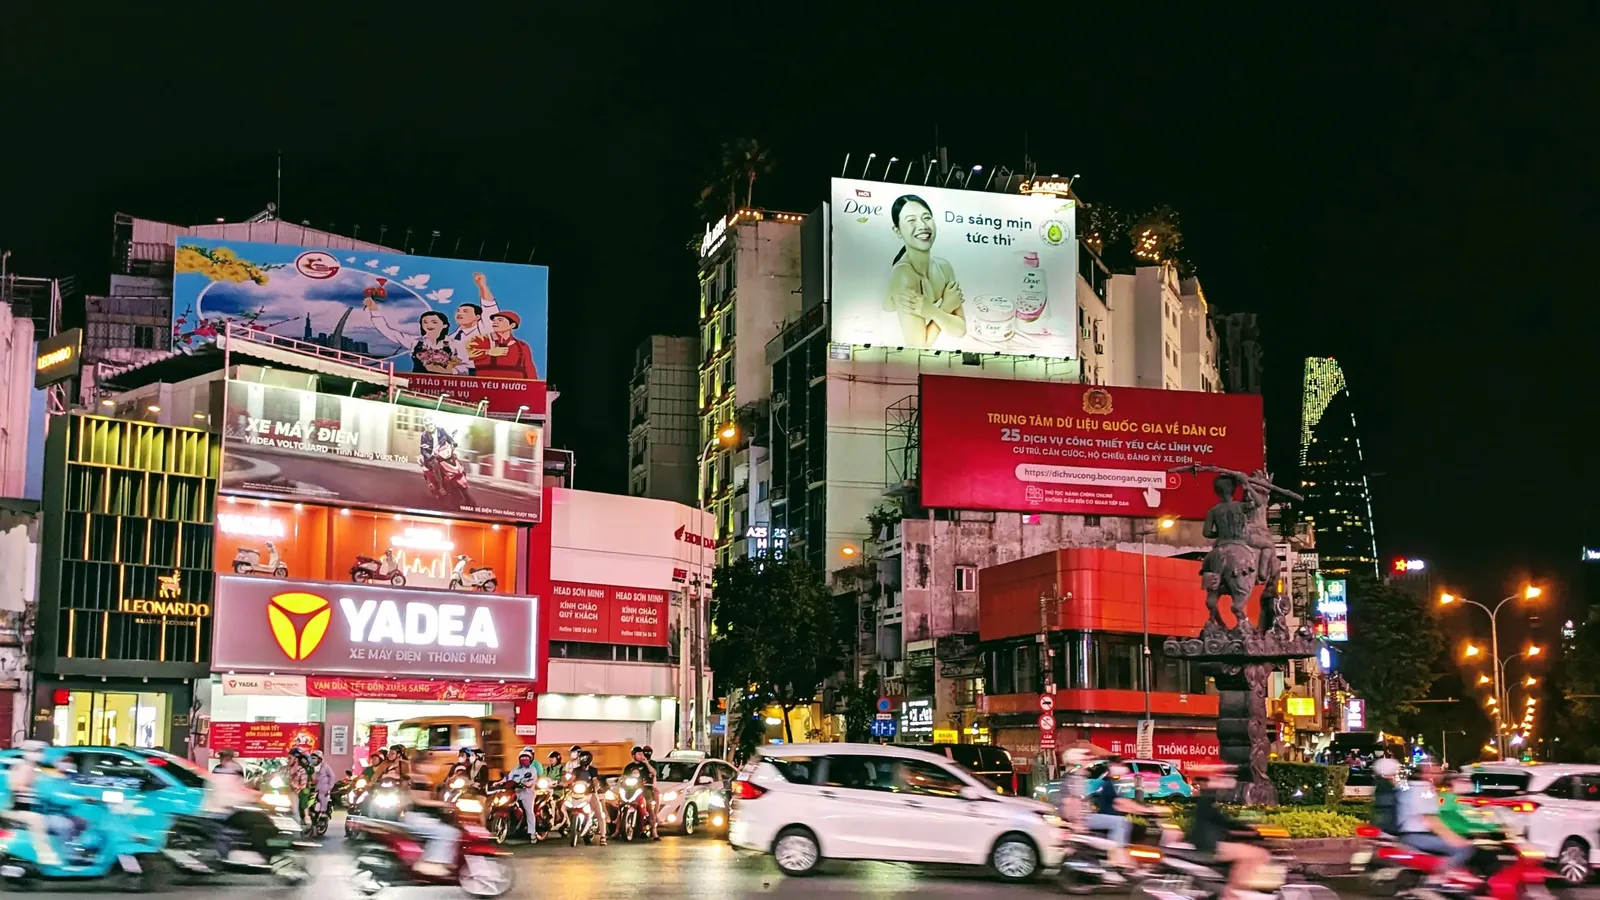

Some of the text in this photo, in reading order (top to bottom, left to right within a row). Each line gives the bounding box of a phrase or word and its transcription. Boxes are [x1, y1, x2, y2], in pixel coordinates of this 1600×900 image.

[843, 198, 883, 216] Dove
[945, 210, 964, 224] Da
[968, 212, 1001, 230] sáng
[1006, 217, 1032, 232] mịn
[966, 231, 989, 245] tức
[442, 379, 458, 387] THI
[481, 380, 499, 389] YÊU
[501, 381, 528, 391] NƯỚC
[457, 390, 470, 399] VỤ
[987, 412, 1027, 425] TRUNG
[1029, 414, 1053, 427] TÂM
[1056, 416, 1074, 428] DỮ
[1076, 417, 1099, 432] LIỆU
[1102, 419, 1139, 433] QUỐC
[1142, 422, 1163, 434] GIA
[1182, 423, 1206, 436] DÂN
[1209, 425, 1227, 437] CƯ
[245, 416, 359, 448] XE MÁY ĐIỆN
[244, 435, 275, 447] YADEA
[276, 439, 329, 454] VOLTGUARD
[1000, 427, 1213, 454] 25 DỊCH VỤ CÔNG THIẾT YẾU CÁC LĨNH VỰC
[1013, 446, 1025, 454] CƯ
[1042, 447, 1060, 456] CĂN
[1087, 449, 1100, 459] HỘ
[1151, 453, 1161, 462] KÝ
[1024, 467, 1163, 484] https://dichvucong.bocongan.gov.vn
[746, 527, 767, 538] A25
[553, 586, 604, 598] HEAD SƠN MINH
[616, 591, 632, 601] HEAD
[633, 592, 646, 602] SƠN
[647, 593, 664, 603] MINH
[123, 599, 210, 616] LEONARDO
[560, 600, 598, 611] KÍNH CHÀO
[621, 605, 657, 616] KÍNH CHÀO
[559, 609, 598, 620] QUÝ KHÁCH
[621, 614, 658, 625] QUÝ KHÁCH
[339, 598, 499, 649] YADEA
[349, 648, 367, 659] XE
[368, 647, 393, 661] MÁY
[395, 650, 422, 665] ĐIỆN
[470, 653, 496, 665] MINH
[313, 681, 331, 692] VẠN
[351, 681, 365, 691] TẾT
[367, 681, 384, 692] ĐÓN
[386, 682, 407, 692] XUÂN
[408, 684, 430, 693] SANG
[1157, 742, 1188, 755] THÔNG
[1189, 743, 1206, 755] BÁO
